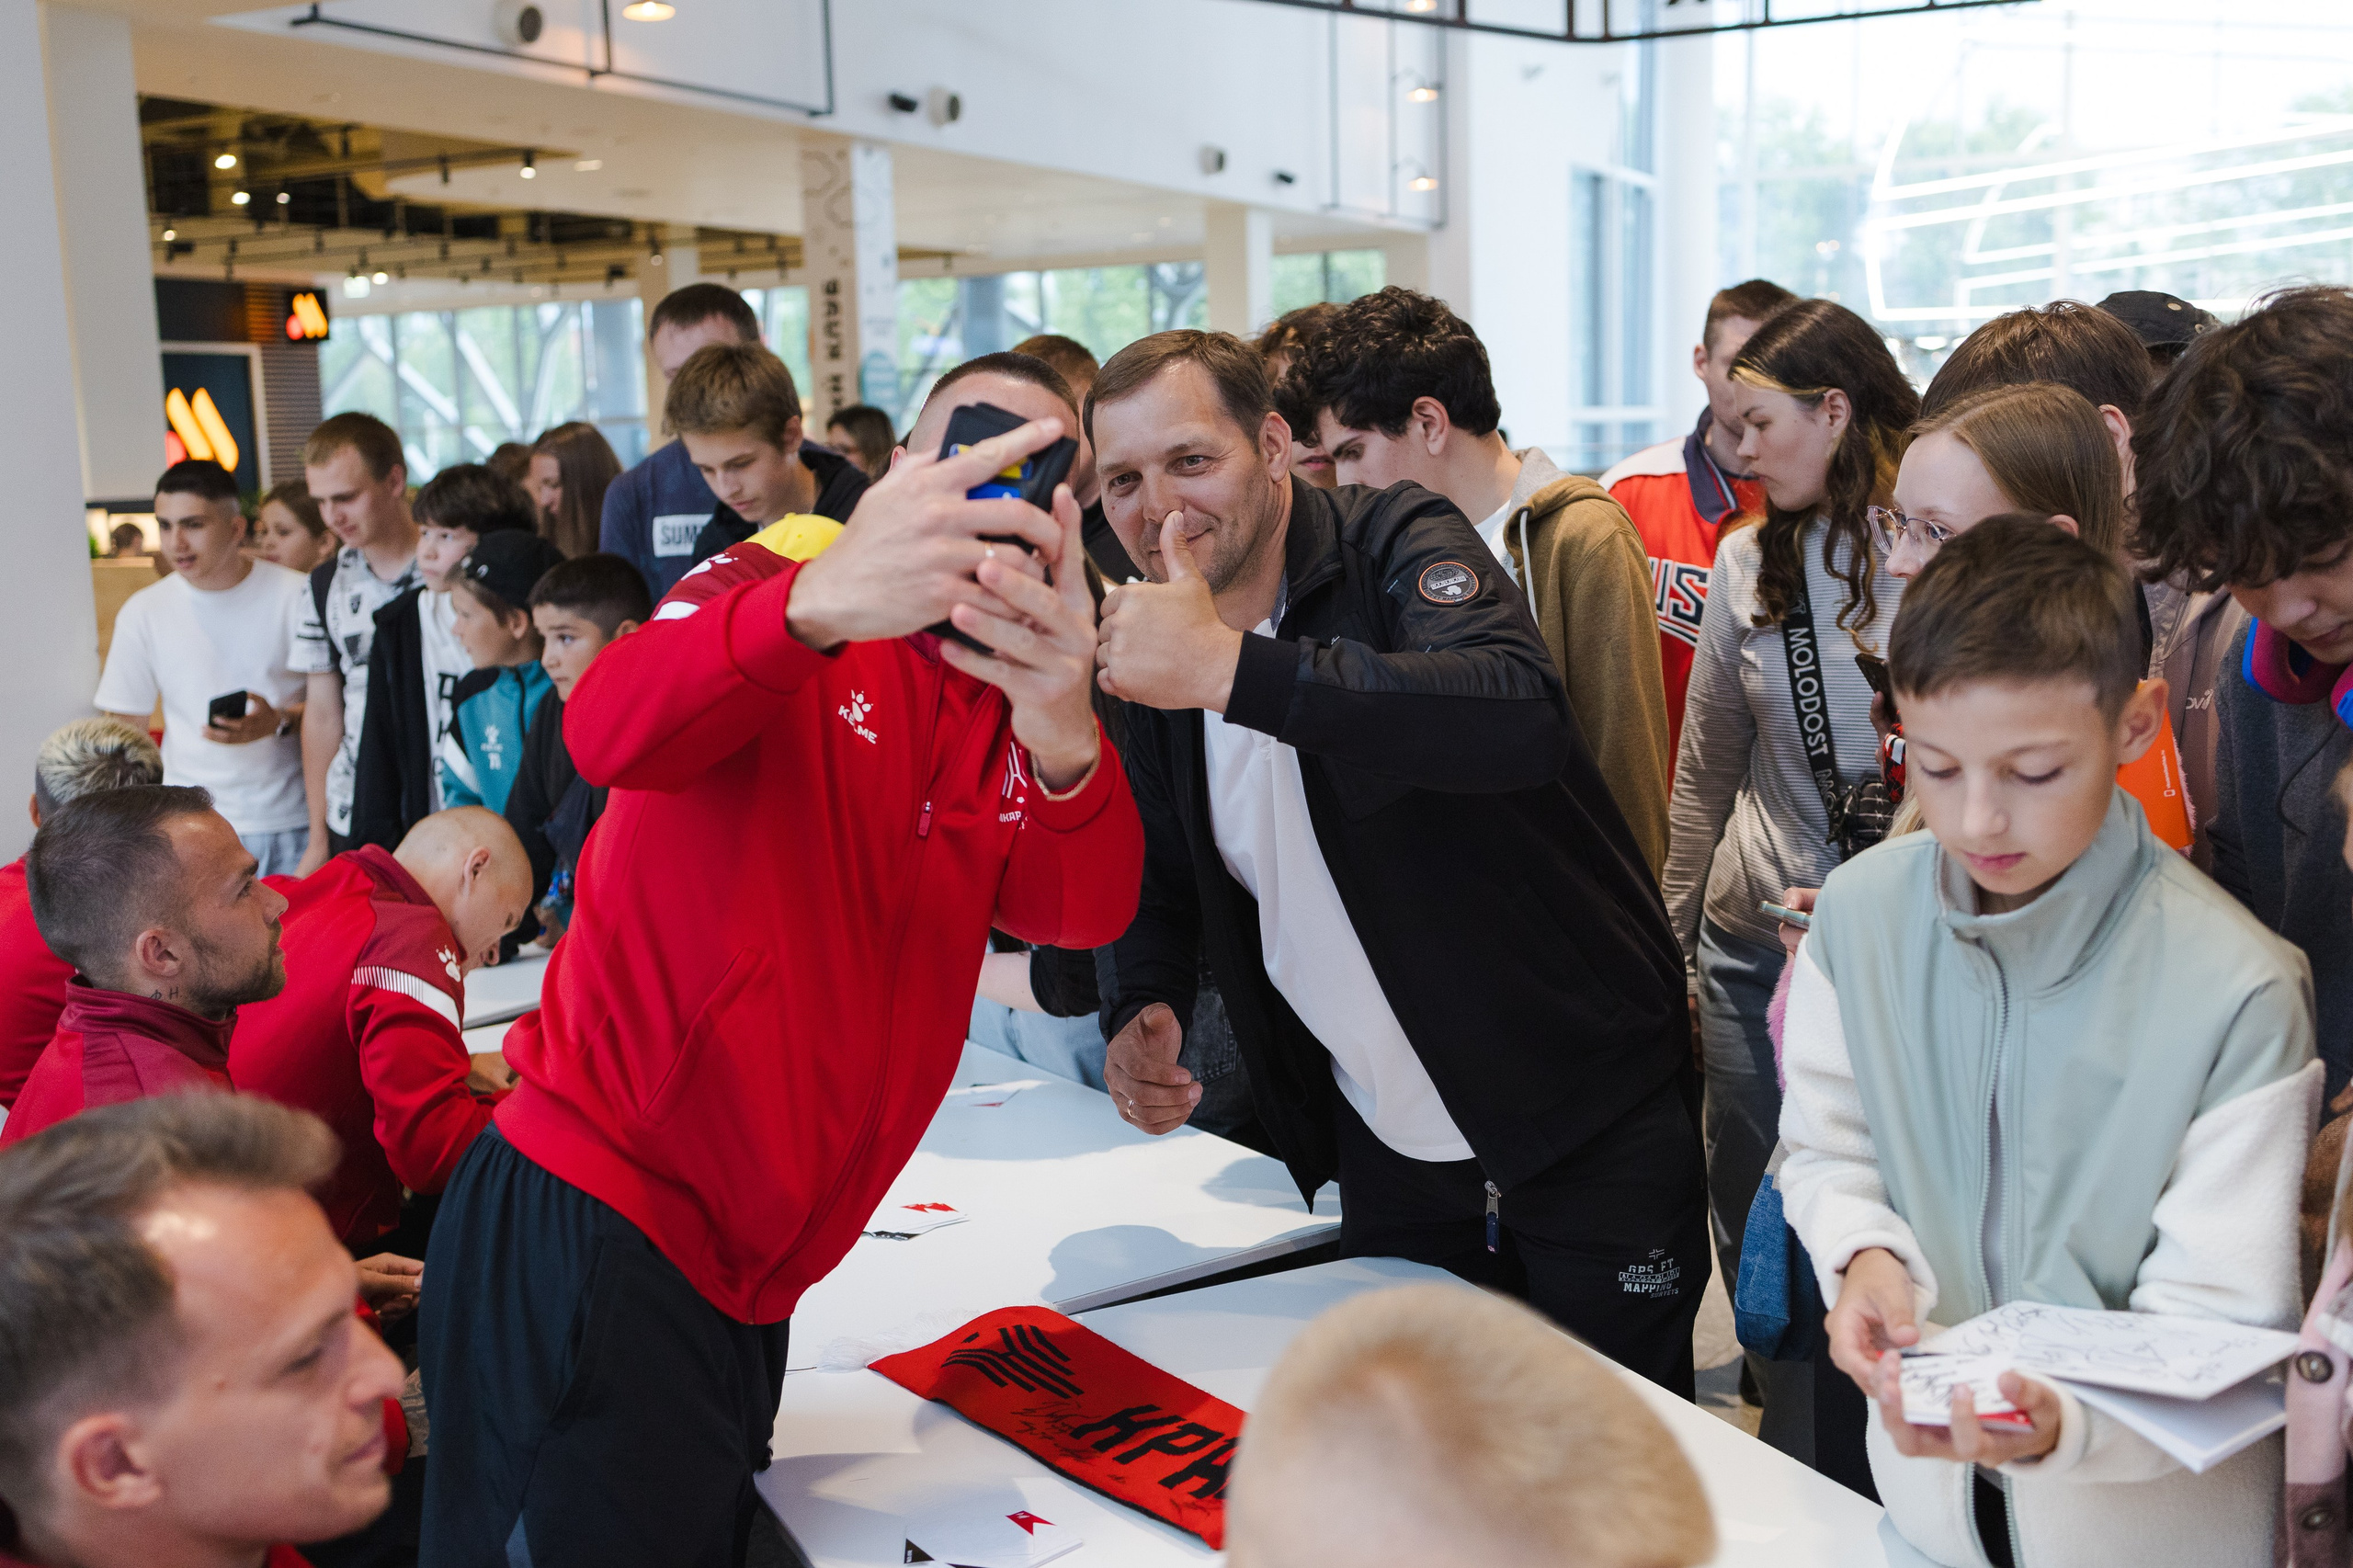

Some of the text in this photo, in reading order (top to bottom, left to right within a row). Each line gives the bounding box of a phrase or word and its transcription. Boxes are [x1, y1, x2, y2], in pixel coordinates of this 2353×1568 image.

[1789, 627, 1828, 756] MOLODOST
[1623, 1281, 1673, 1293] MAPPING
[1661, 1258, 1674, 1271] FT
[1069, 1403, 1242, 1500] КРА
